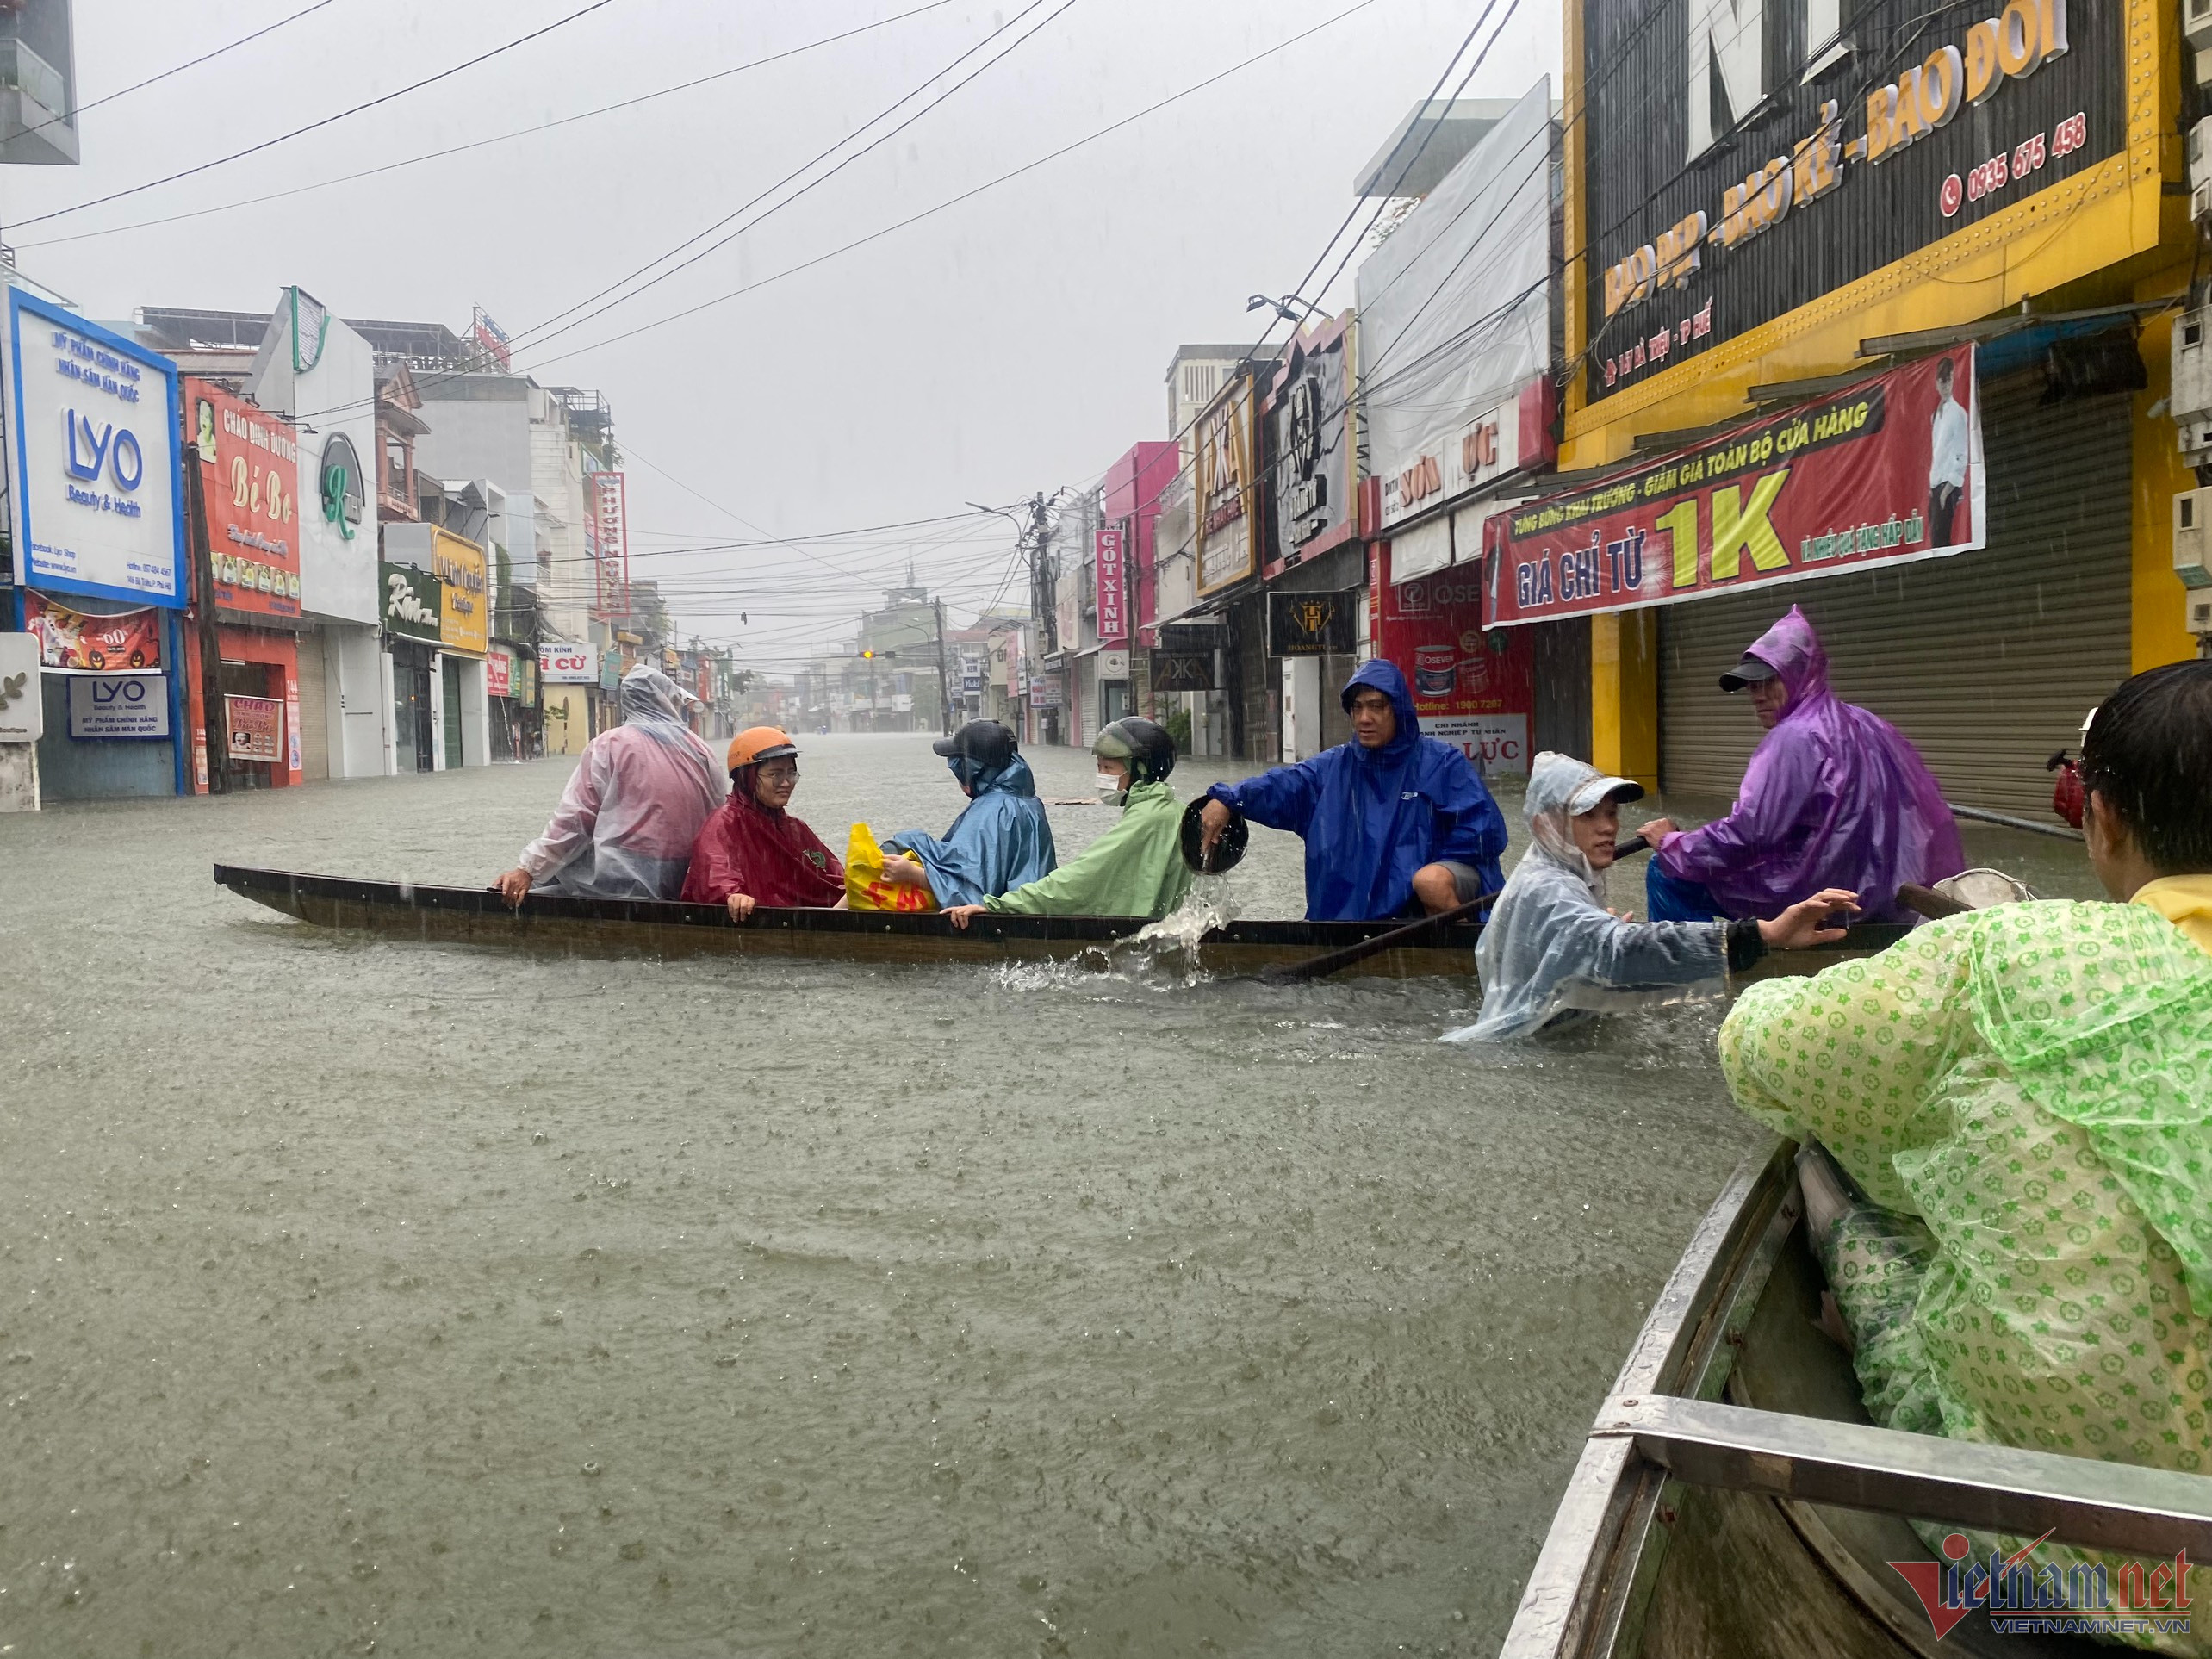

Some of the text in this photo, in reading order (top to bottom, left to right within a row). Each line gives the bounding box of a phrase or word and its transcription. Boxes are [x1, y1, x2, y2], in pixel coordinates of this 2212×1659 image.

[1968, 112, 2086, 202] 0935 675 458
[1605, 244, 1656, 318] BAO
[1724, 156, 1793, 250] BAO
[1867, 45, 1963, 165] BAO
[1693, 295, 1713, 339] HUẾ
[62, 407, 142, 492] LYO
[249, 420, 269, 450] DINH
[1565, 499, 1590, 521] KHAI
[1644, 467, 1677, 497] GIẢM
[1680, 454, 1704, 486] GIÁ
[1707, 444, 1747, 477] TOÀN
[1749, 430, 1772, 466] BỘ
[1776, 418, 1808, 455] CỬA
[1813, 401, 1869, 442] HÀNG
[66, 483, 101, 510] Beauty
[113, 497, 141, 518] Health
[1656, 468, 1791, 589] 1K
[1880, 513, 1903, 549] HẤP
[1904, 508, 1923, 544] DẪN
[1101, 533, 1119, 633] GÓT XINH
[1517, 525, 1647, 608] GIÁ CHỈ TỪ
[1425, 654, 1454, 665] OSEVEN
[92, 680, 145, 703] LYO
[1456, 700, 1478, 710] 1900
[1463, 737, 1519, 765] LỰC
